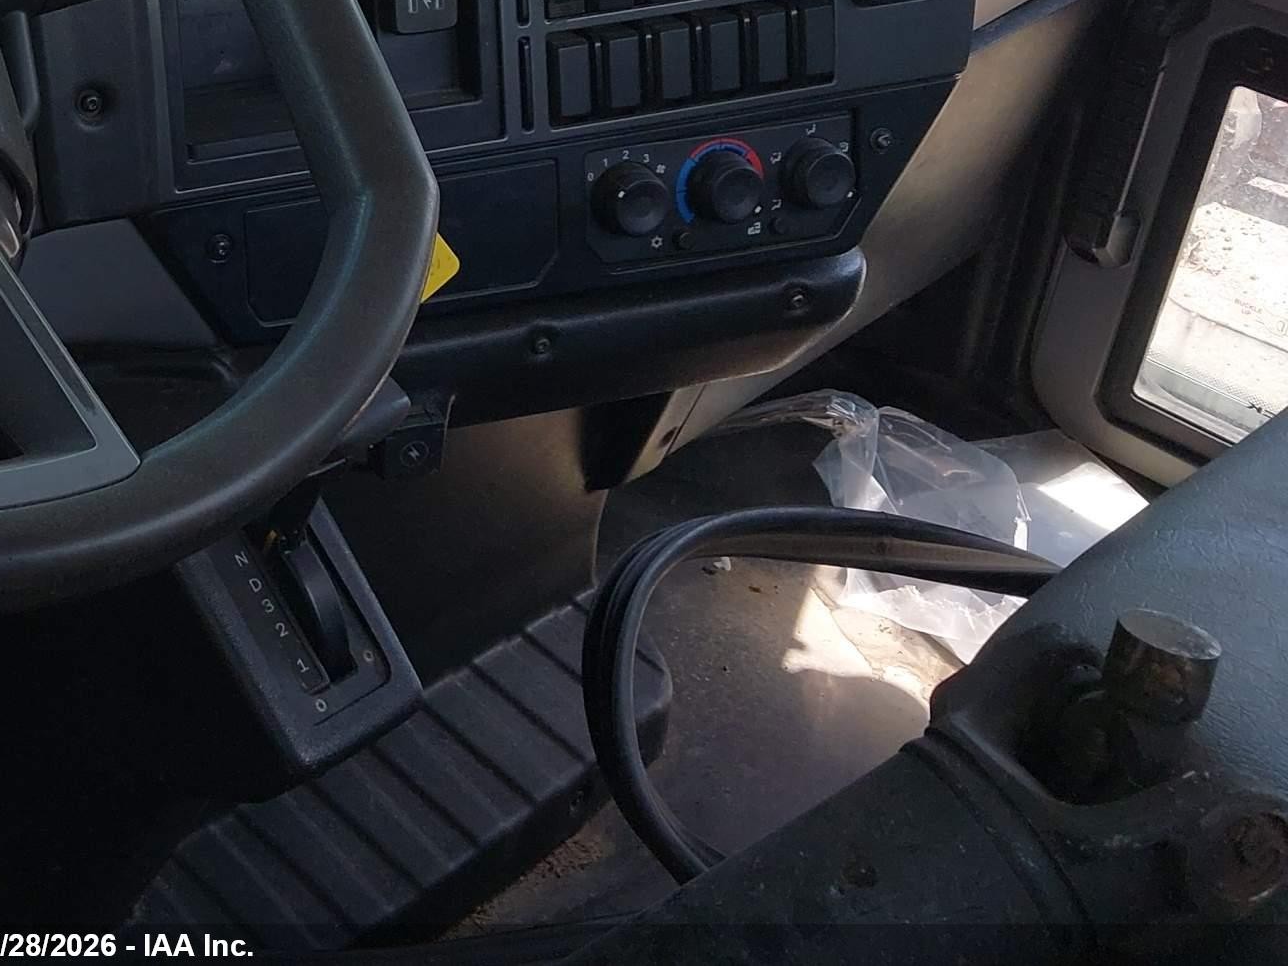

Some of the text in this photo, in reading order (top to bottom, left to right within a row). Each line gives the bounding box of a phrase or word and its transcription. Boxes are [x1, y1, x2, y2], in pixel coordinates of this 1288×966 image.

[587, 150, 650, 182] 0 1 2 3
[234, 551, 310, 673] N D 3 2 1
